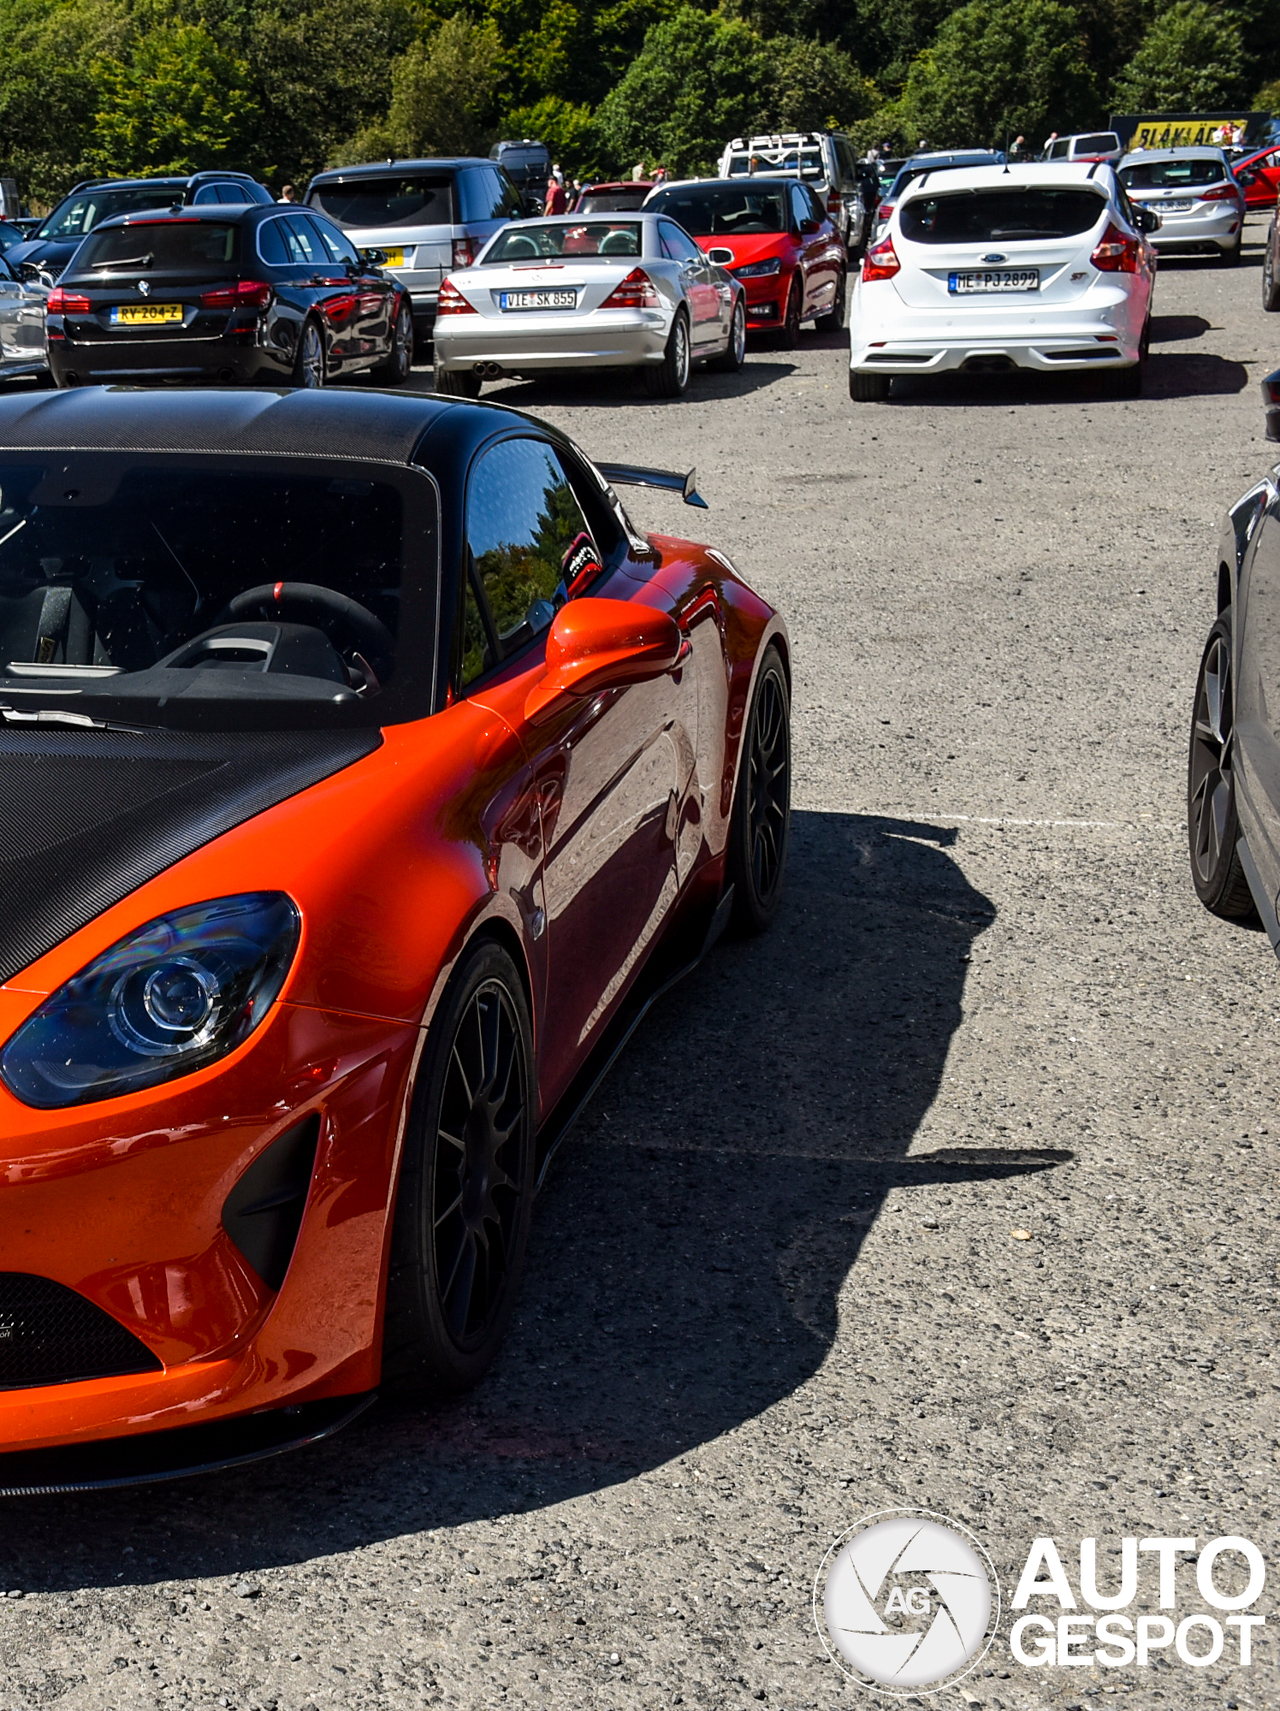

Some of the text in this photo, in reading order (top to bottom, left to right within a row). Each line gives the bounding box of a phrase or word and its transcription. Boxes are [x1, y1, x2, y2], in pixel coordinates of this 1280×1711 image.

[958, 272, 1036, 288] ME PJ 2899
[508, 291, 574, 307] VIE SK 855
[121, 307, 177, 319] RV-204-Z
